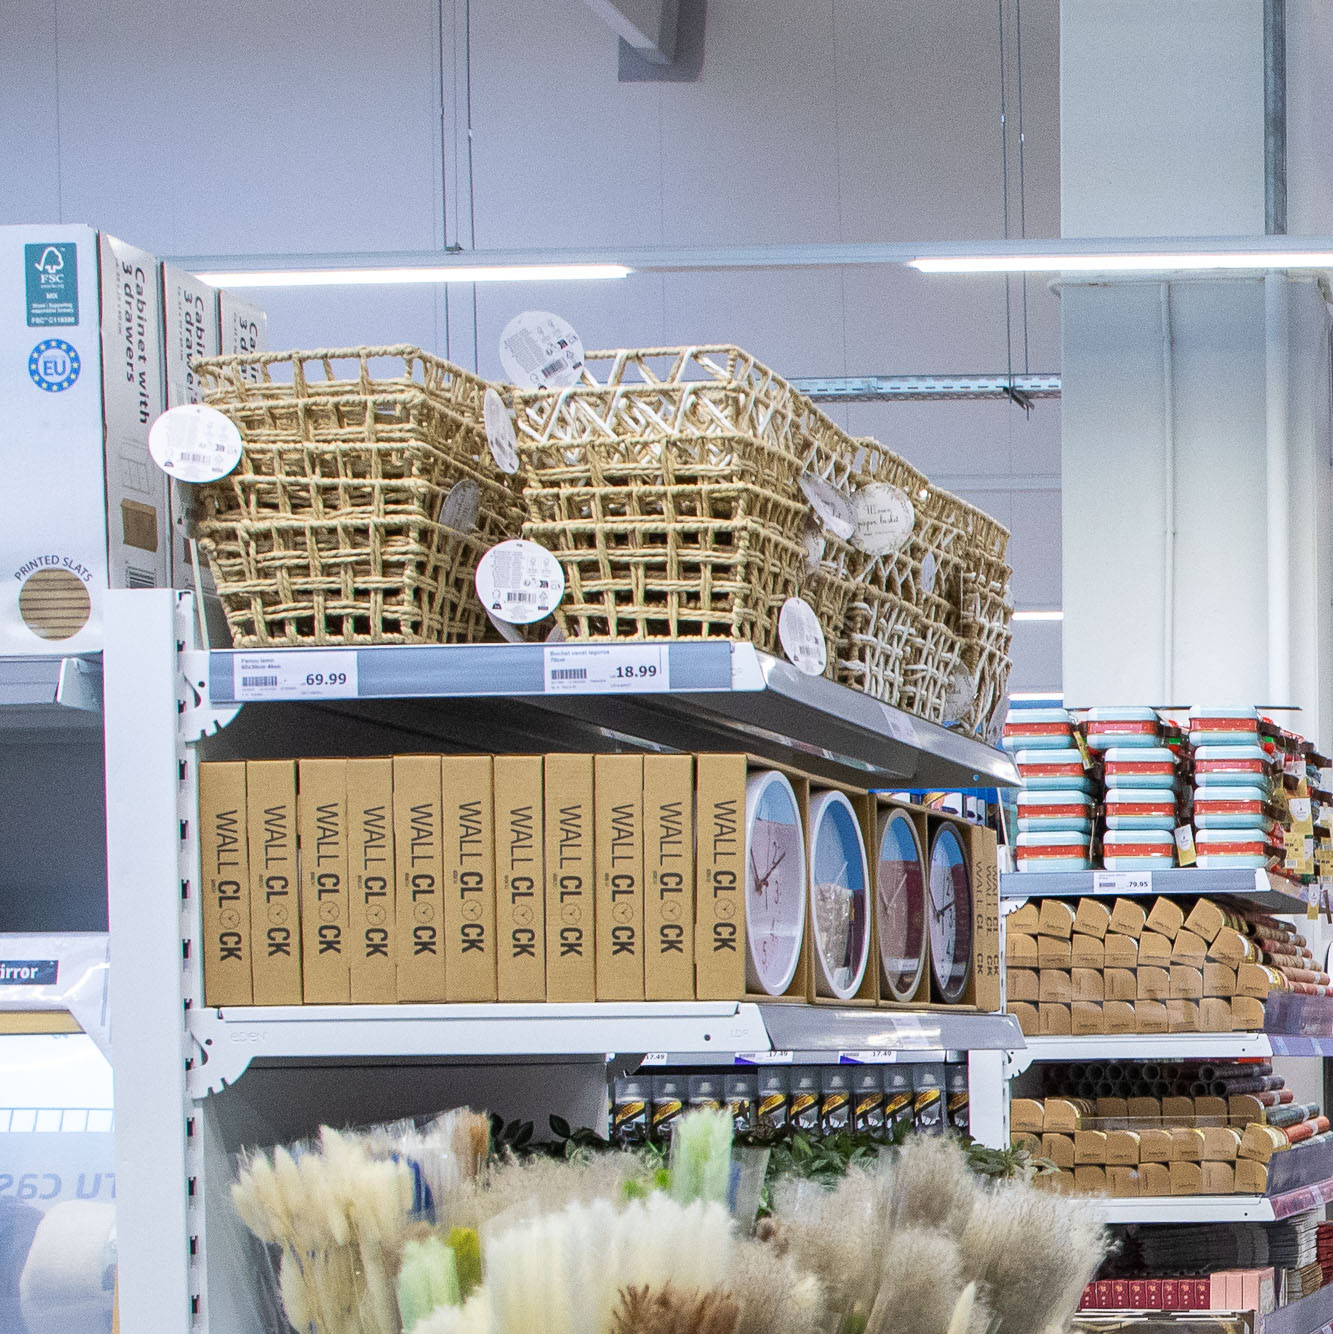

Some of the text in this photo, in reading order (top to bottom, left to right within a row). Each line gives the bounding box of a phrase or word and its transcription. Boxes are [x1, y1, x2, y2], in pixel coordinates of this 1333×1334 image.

[40, 274, 65, 283] FSC
[122, 261, 135, 383] 3 drawers
[134, 266, 150, 424] Cabinet with
[43, 360, 66, 376] EU
[14, 555, 93, 582] PRINTED SLATS
[306, 672, 347, 686] 69.99
[616, 665, 657, 678] 18.99
[216, 809, 239, 875] WALL
[264, 805, 288, 870] WALL
[316, 803, 340, 868] WALL
[364, 806, 387, 871] WALL
[411, 804, 434, 868] WALL
[459, 801, 483, 866] WALL
[511, 806, 534, 871] WALL
[560, 805, 582, 870] WALL
[612, 804, 634, 869] WALL
[660, 802, 683, 867] WALL
[714, 800, 737, 865] WALL
[0, 965, 38, 980] irror
